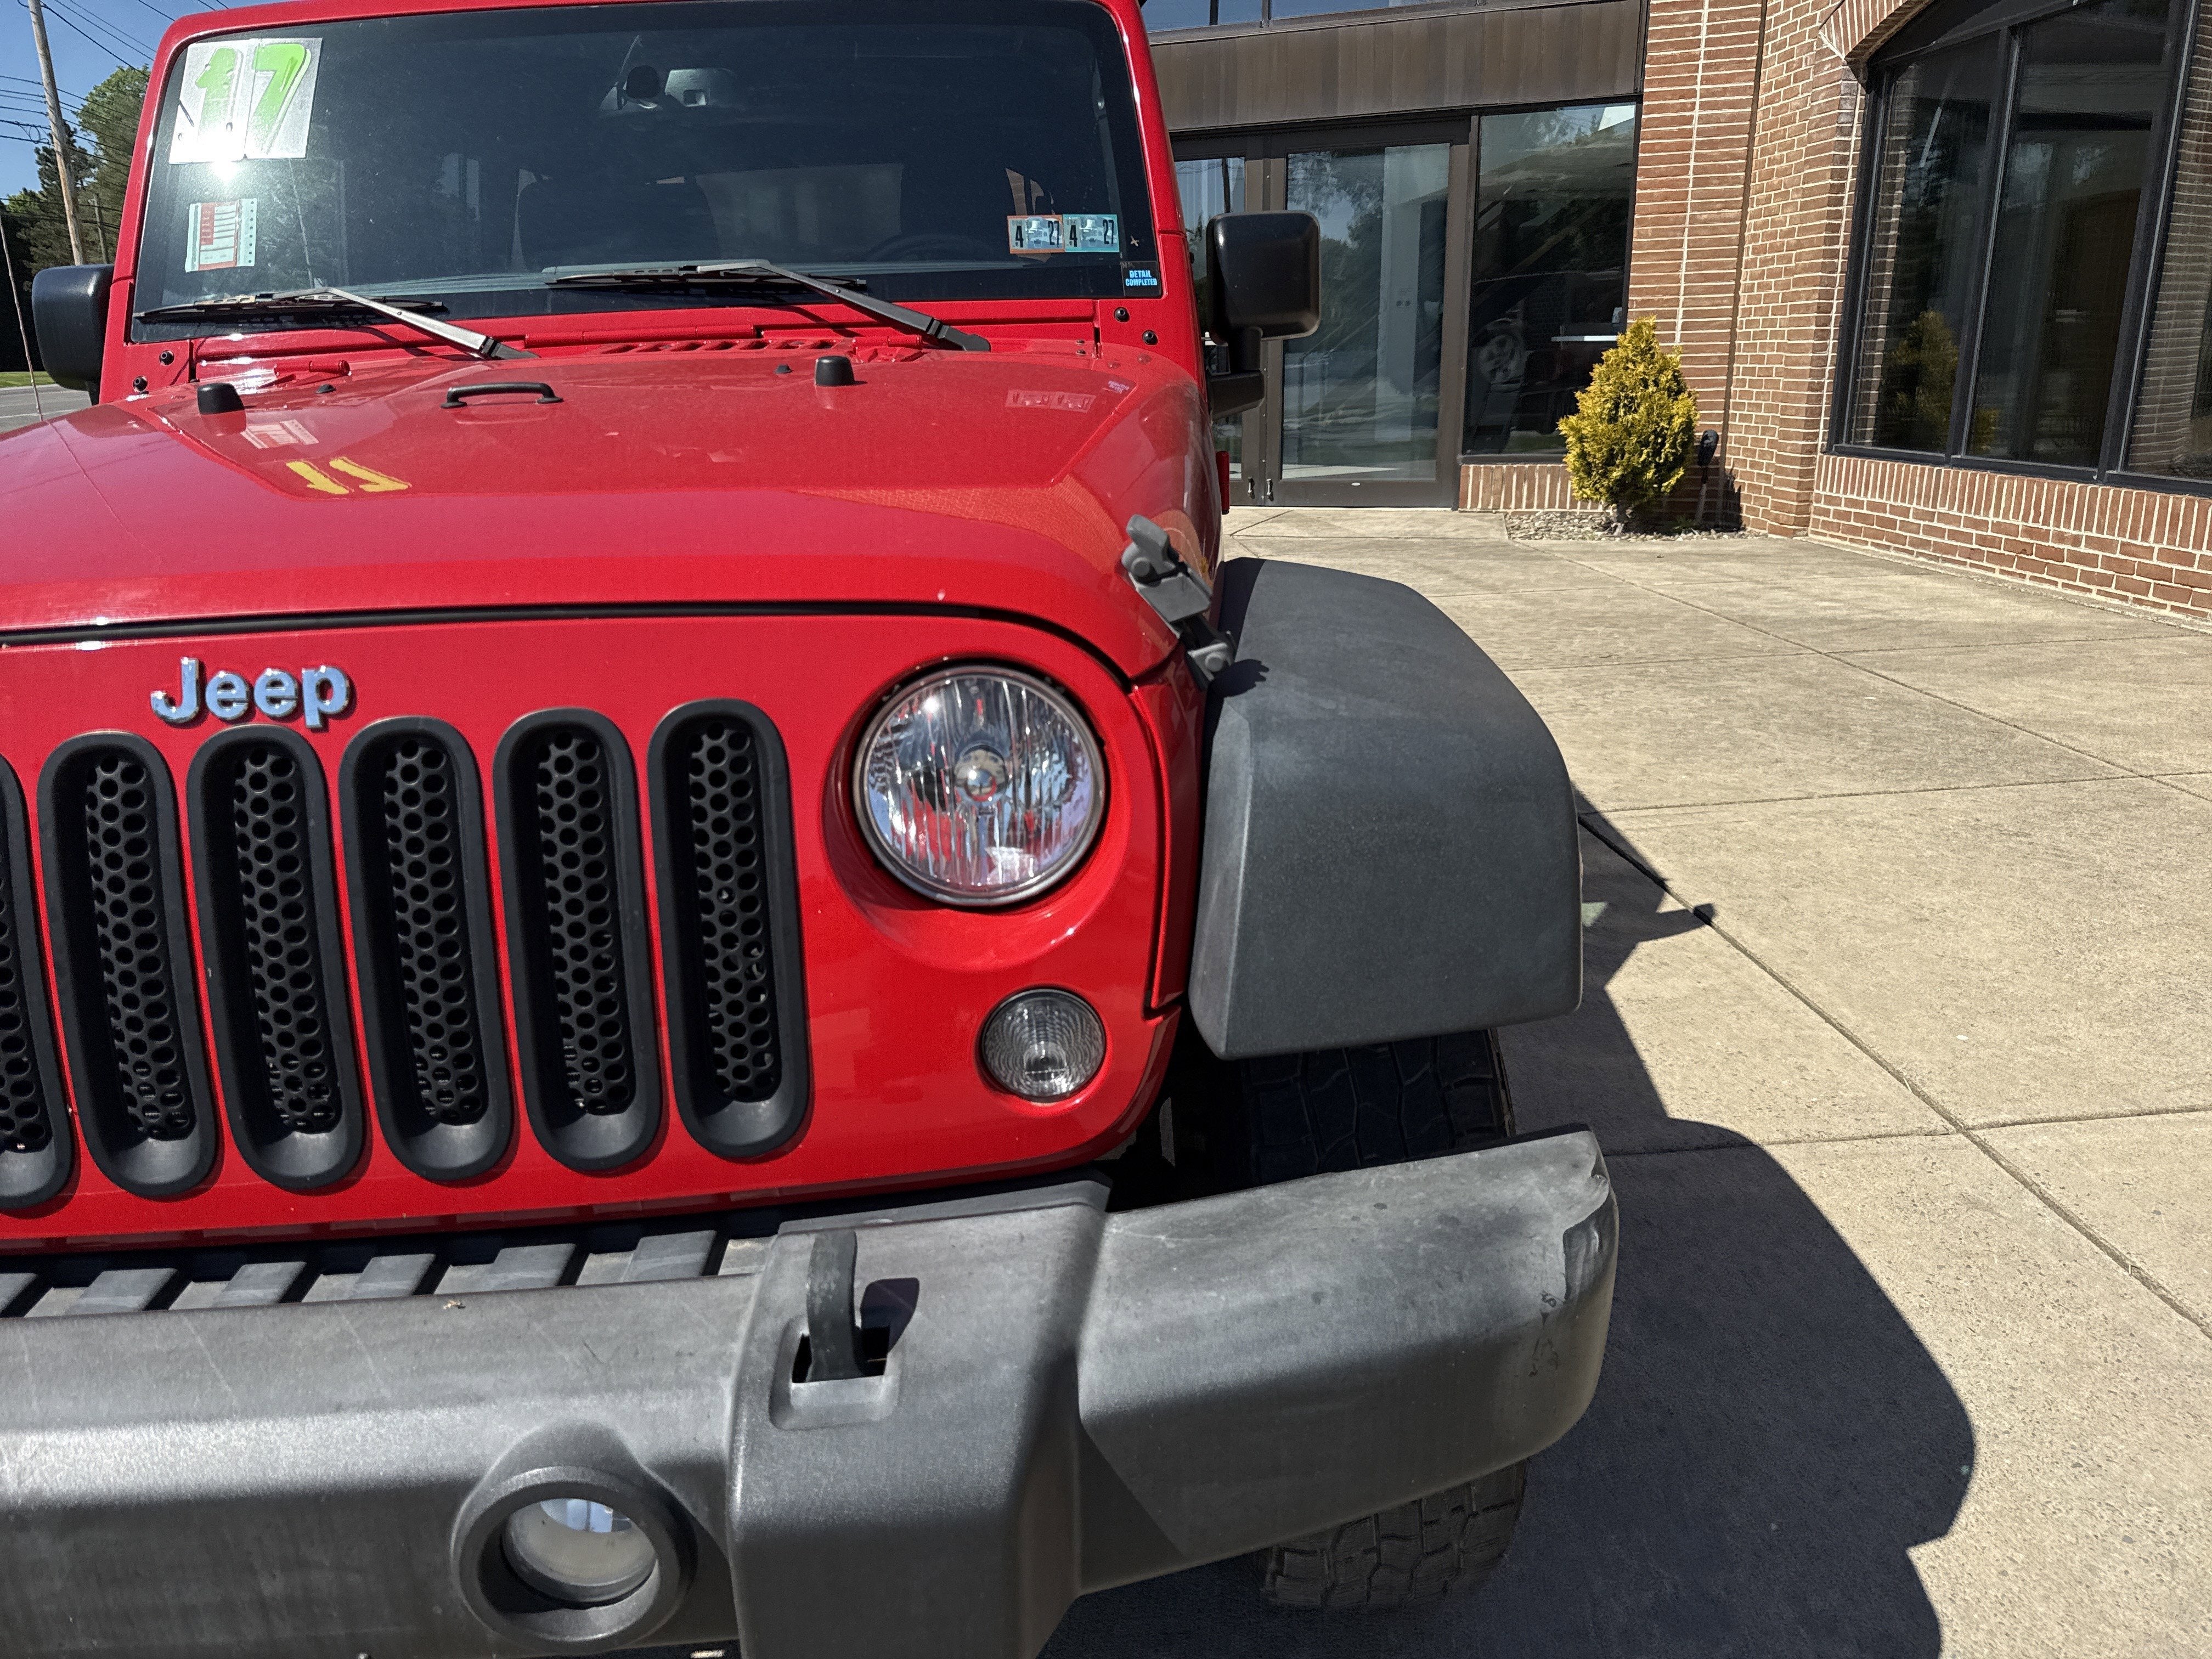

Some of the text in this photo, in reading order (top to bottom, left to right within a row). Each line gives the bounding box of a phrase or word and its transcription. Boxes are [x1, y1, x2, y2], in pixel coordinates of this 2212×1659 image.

[195, 43, 312, 157] 17
[1015, 221, 1059, 248] 4 27
[1070, 219, 1114, 247] 4 27
[151, 657, 349, 729] Jeep
